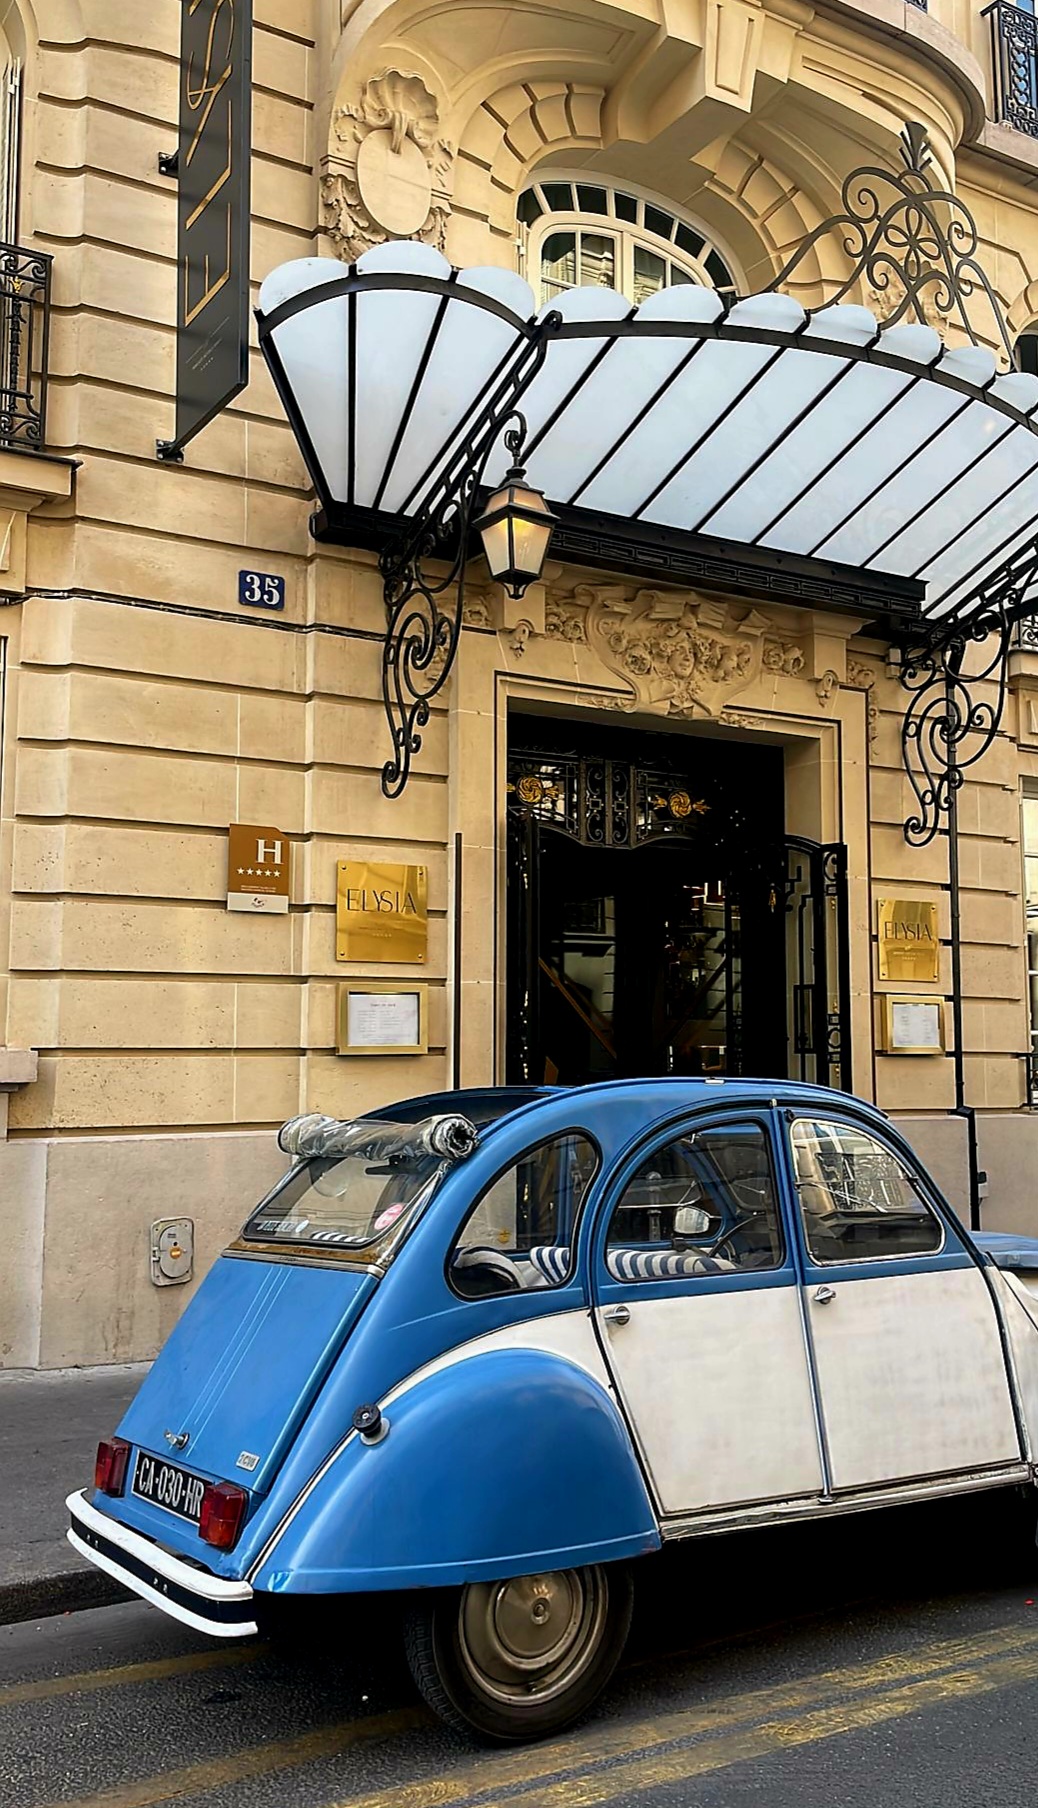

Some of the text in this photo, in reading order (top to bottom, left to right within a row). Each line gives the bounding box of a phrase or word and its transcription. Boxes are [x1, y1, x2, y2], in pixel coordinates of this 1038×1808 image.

[185, 0, 234, 327] ELYS
[245, 574, 280, 605] 35
[255, 839, 284, 865] H
[346, 888, 417, 914] ELYSIA
[884, 921, 933, 941] ELYSIA
[139, 1457, 204, 1517] CA-030-HR
